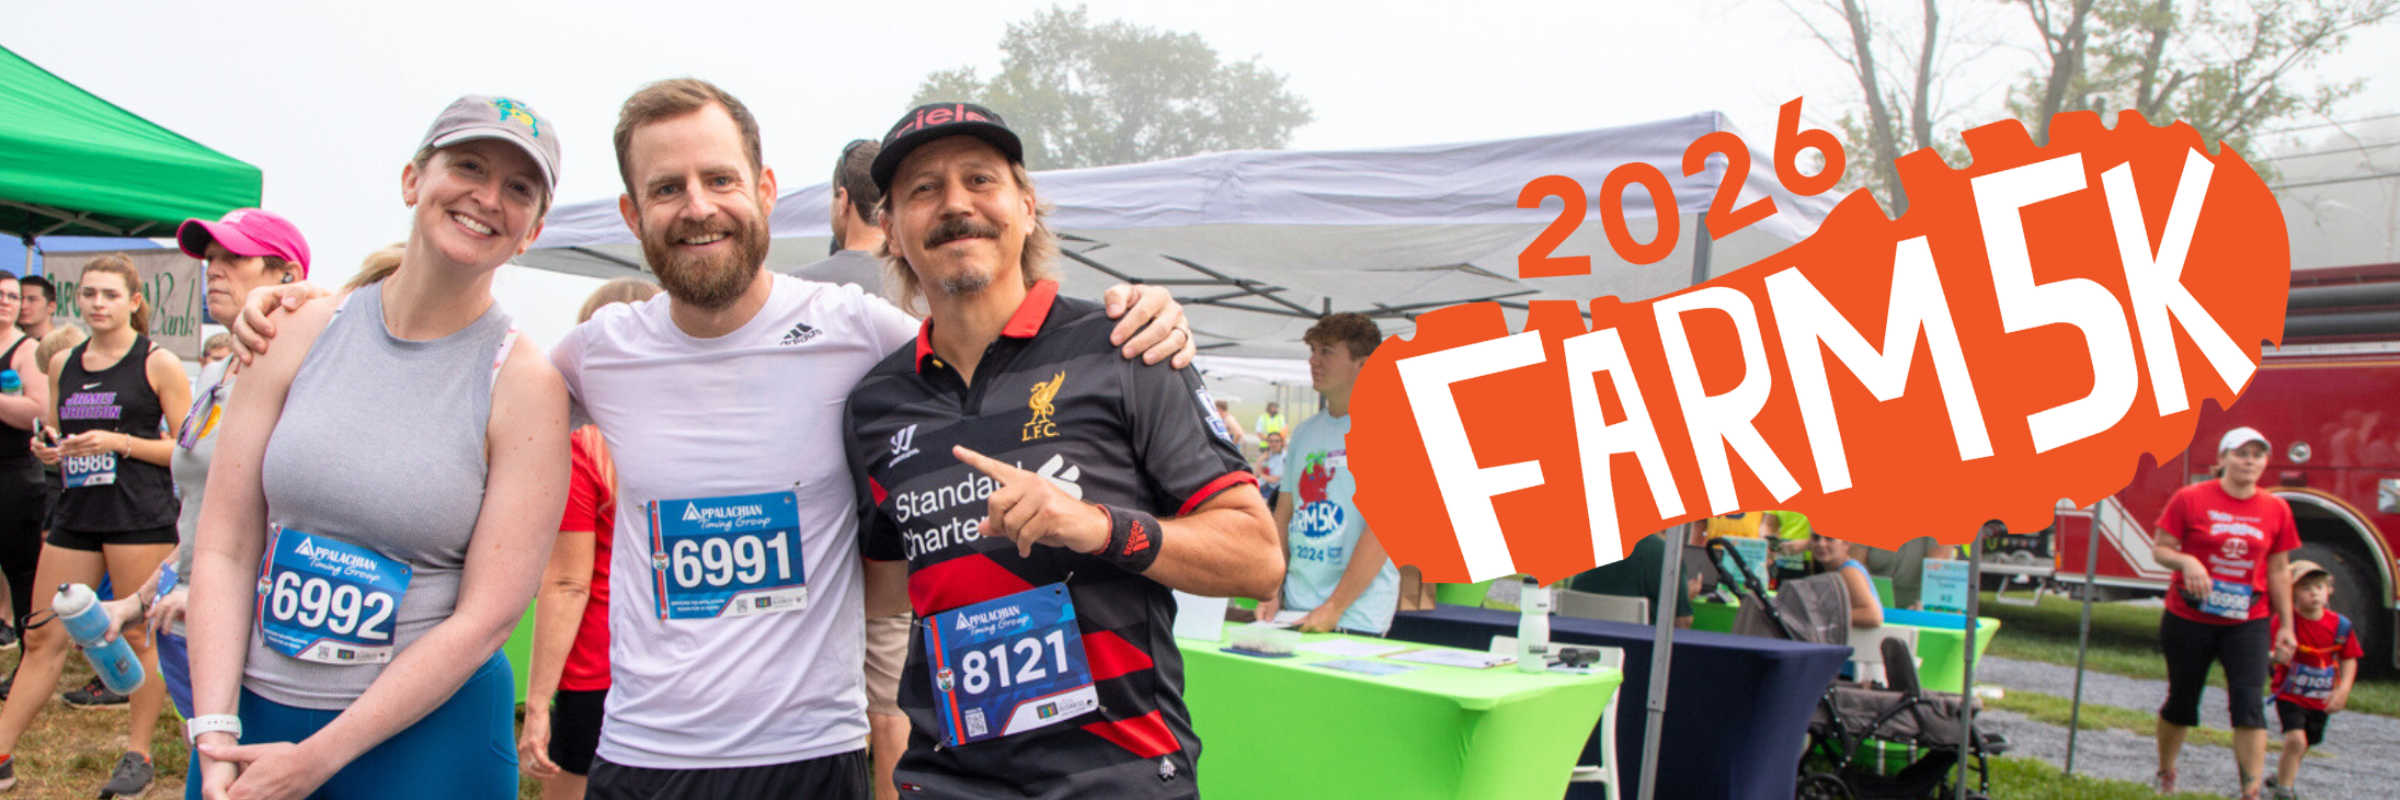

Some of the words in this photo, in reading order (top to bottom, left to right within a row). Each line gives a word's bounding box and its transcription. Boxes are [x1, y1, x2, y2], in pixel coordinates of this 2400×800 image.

[151, 272, 195, 336] Bank
[68, 451, 115, 474] 6986
[895, 461, 1022, 523] Standa
[682, 501, 763, 520] APPALACHIAN
[698, 517, 733, 532] Timing
[735, 515, 772, 528] Group
[294, 536, 378, 571] APPALACHIAN
[672, 531, 791, 588] 6991
[1297, 545, 1324, 562] 2024
[308, 556, 342, 576] Timing
[344, 565, 381, 584] Group
[272, 571, 394, 640] 6992
[998, 615, 1029, 630] Group
[962, 629, 1068, 695] 8121
